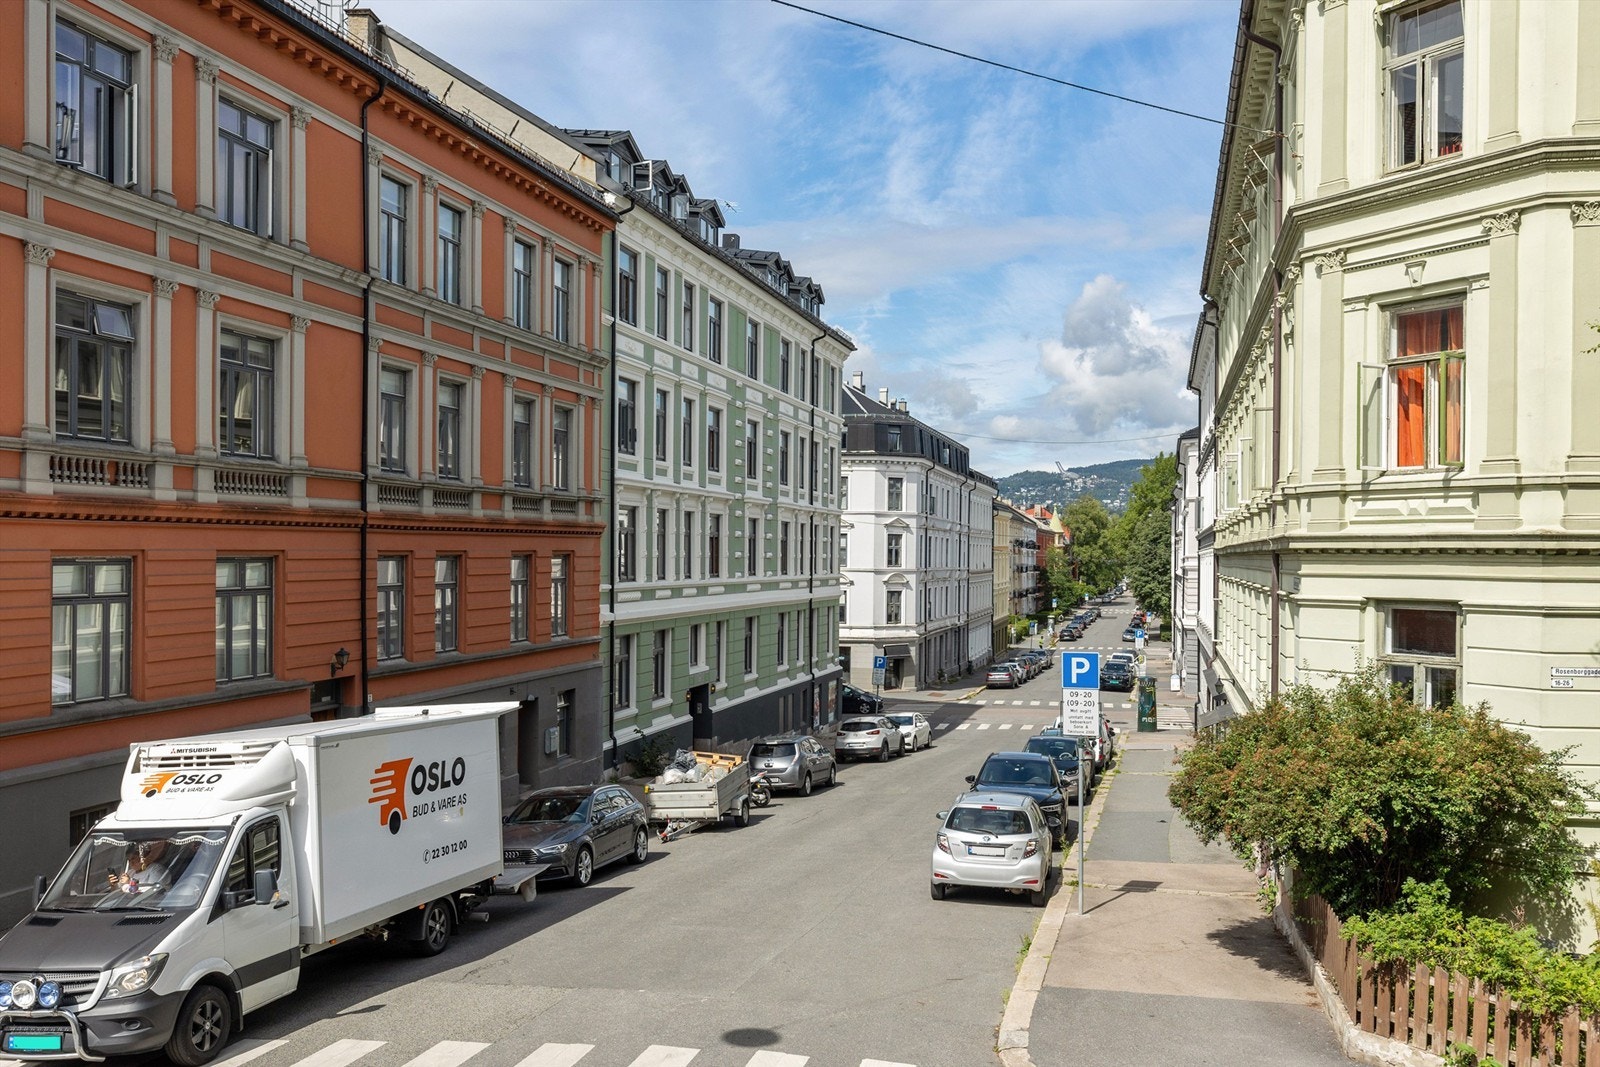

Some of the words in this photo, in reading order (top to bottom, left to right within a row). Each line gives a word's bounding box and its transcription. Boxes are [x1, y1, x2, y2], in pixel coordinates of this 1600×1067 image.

[1071, 657, 1090, 684] P
[171, 774, 222, 785] OSLO
[411, 757, 466, 795] OSLO
[412, 803, 429, 817] BUD
[431, 801, 436, 813] &
[437, 796, 456, 811] VARE
[457, 793, 467, 805] AS
[432, 848, 440, 859] 22
[441, 846, 450, 856] 30
[451, 843, 457, 853] 12
[459, 840, 467, 850] 00
